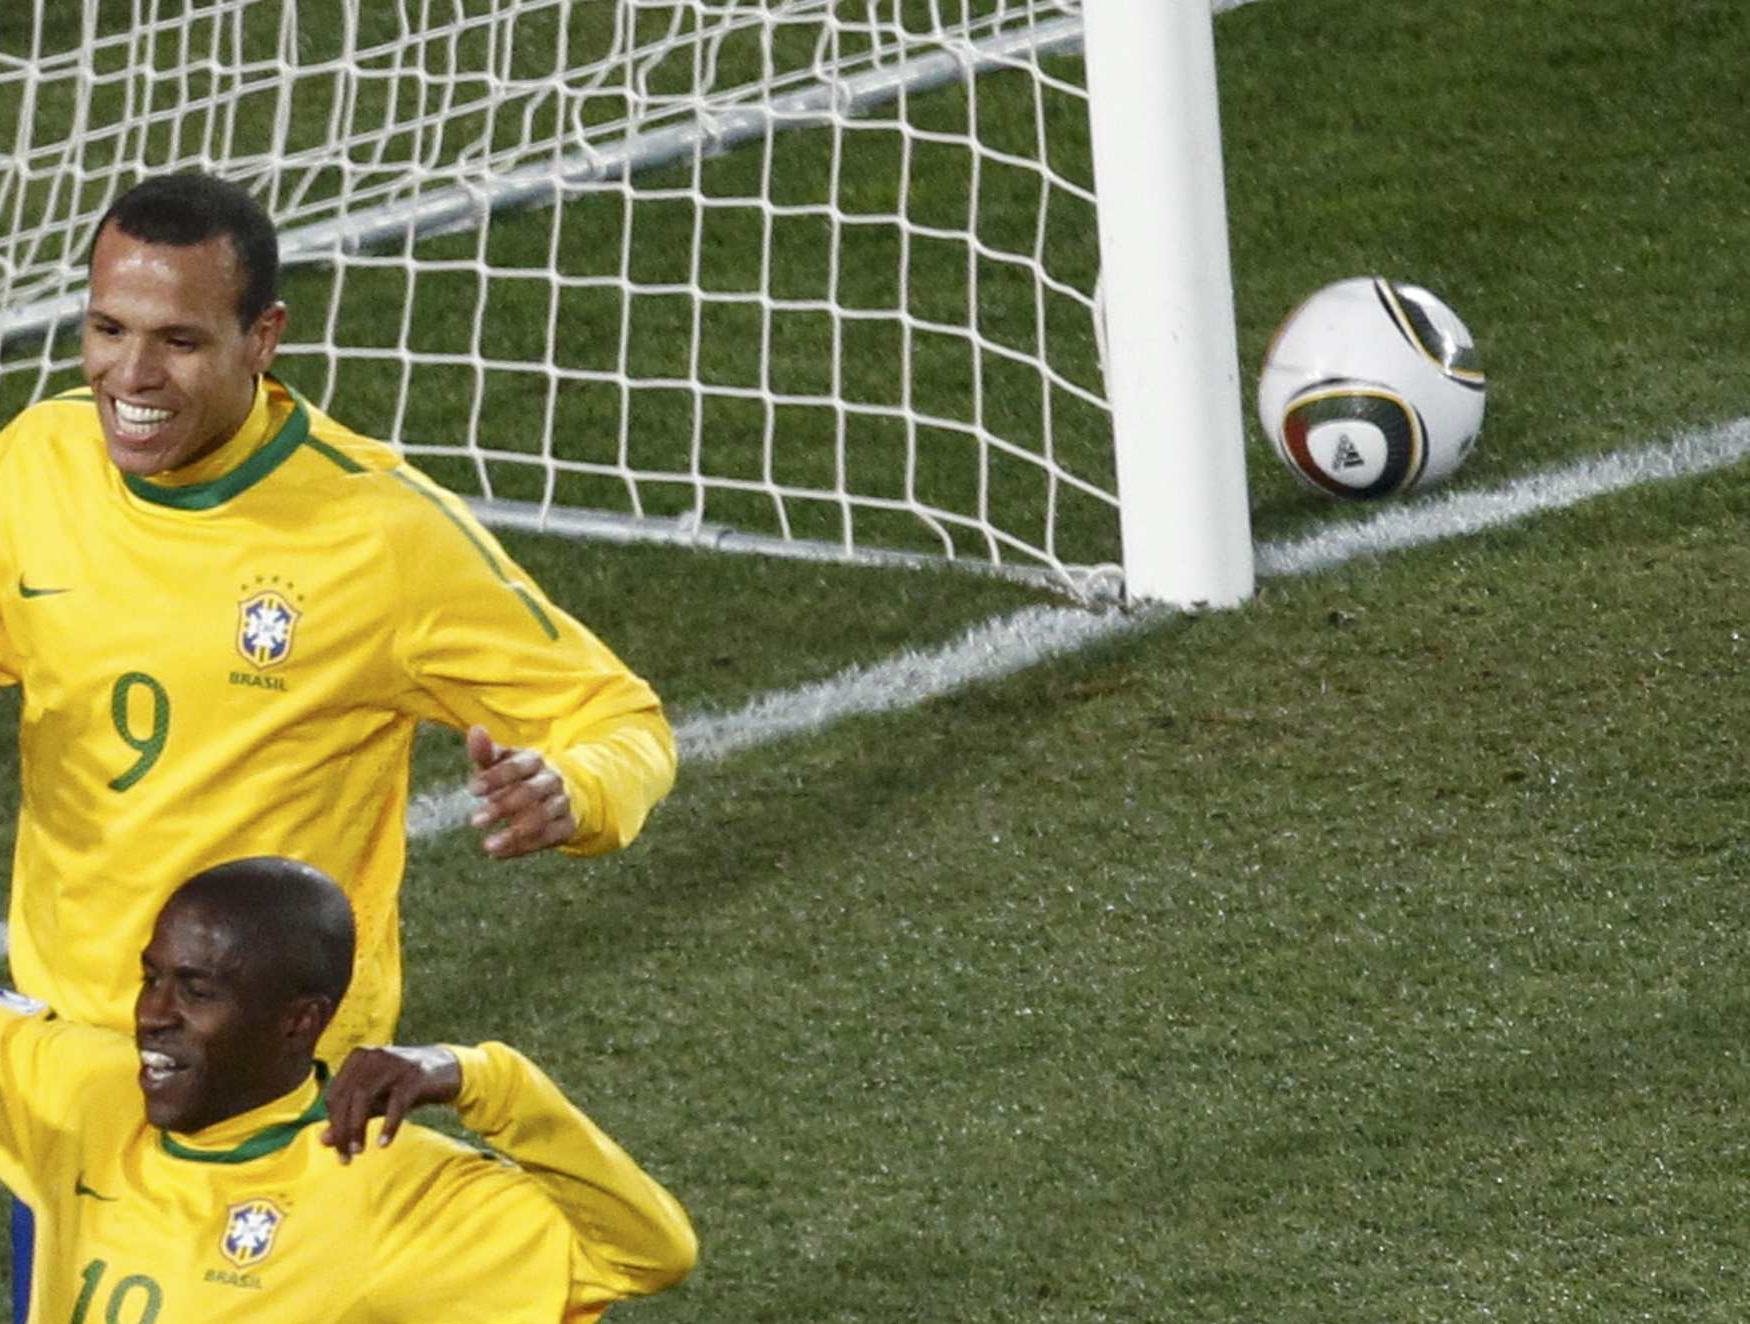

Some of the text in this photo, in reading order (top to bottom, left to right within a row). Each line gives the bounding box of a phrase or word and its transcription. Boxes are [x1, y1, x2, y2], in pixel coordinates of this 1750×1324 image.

[229, 671, 288, 692] BRASIL
[108, 671, 170, 793] 9
[203, 1268, 263, 1290] BRASIL
